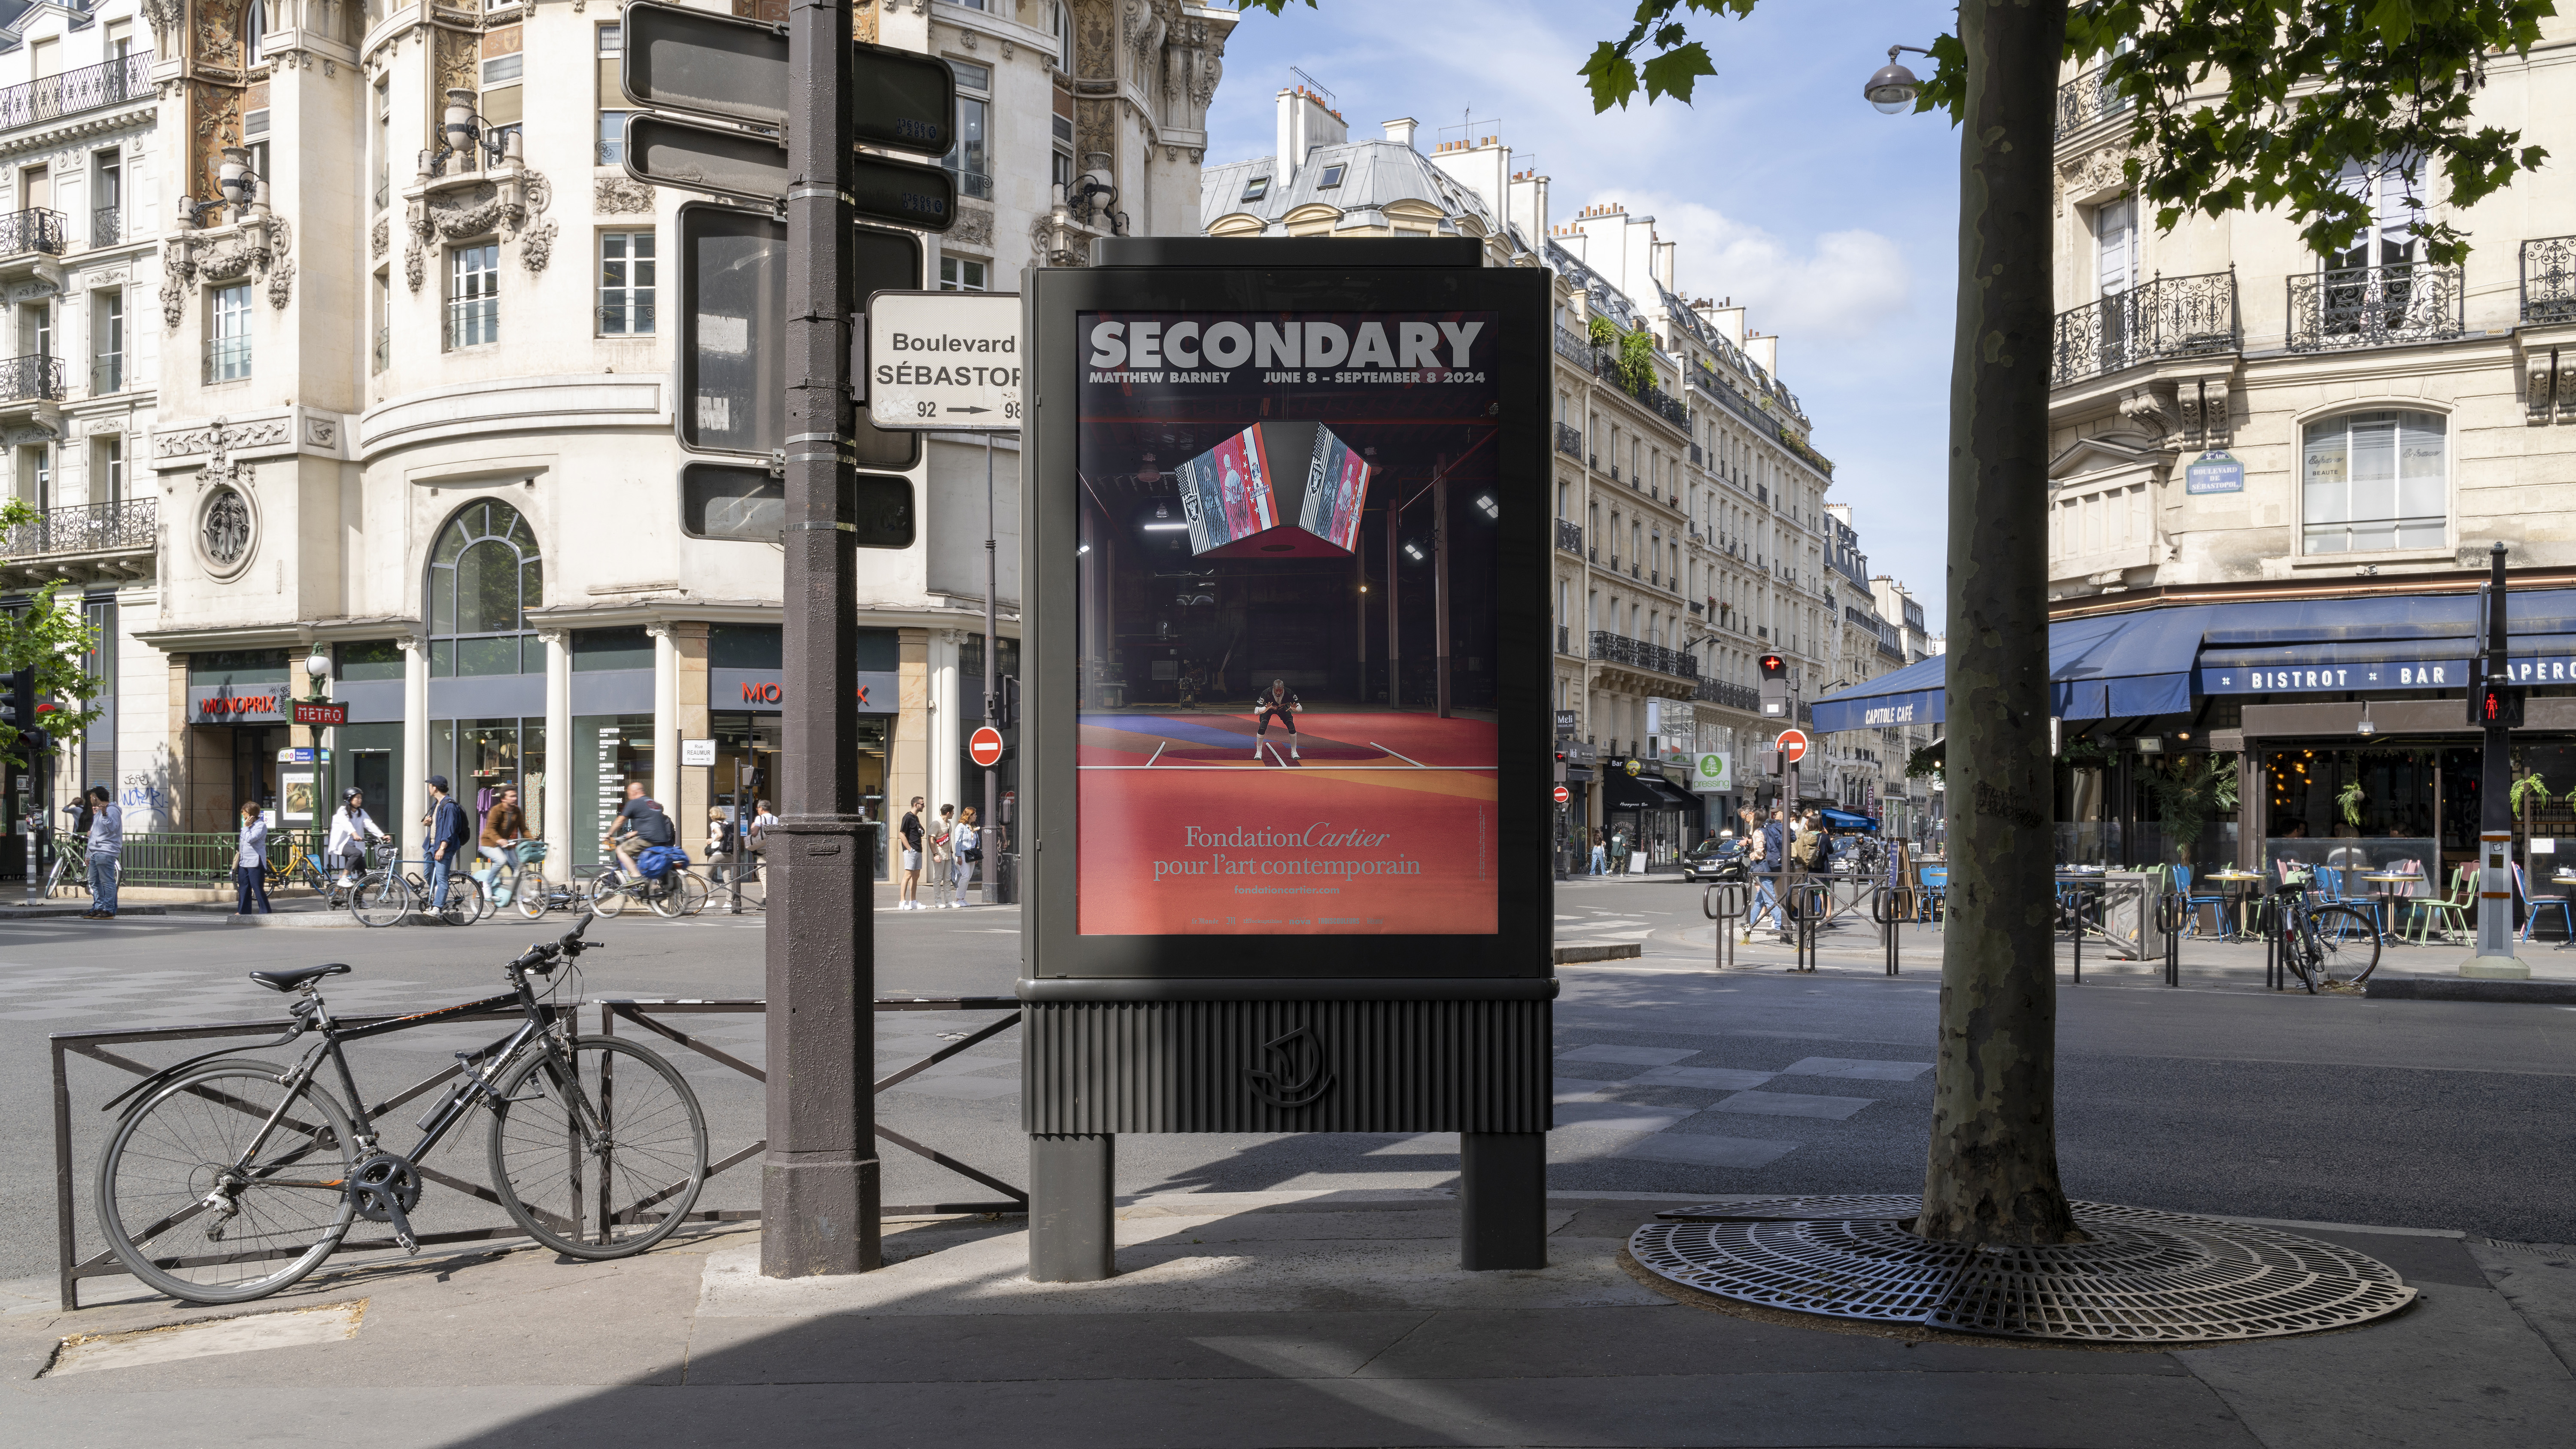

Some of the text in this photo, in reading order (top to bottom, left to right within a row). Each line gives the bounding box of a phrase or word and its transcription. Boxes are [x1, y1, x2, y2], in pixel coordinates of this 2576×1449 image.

[893, 333, 1015, 352] Boulevard
[1090, 321, 1485, 368] SECONDARY
[1089, 372, 1231, 383] MATTHEW BARNEY
[1263, 372, 1300, 383] JUNE
[1307, 372, 1316, 383] 8
[1335, 372, 1420, 383] SEPTEMBER
[1427, 372, 1436, 383] 8
[1443, 372, 1485, 383] 2024
[917, 401, 936, 417] 92
[2308, 455, 2344, 468] Espace
[2403, 448, 2441, 461] Espace
[2192, 482, 2238, 490] SÉBASTOPOL
[2252, 670, 2347, 688] BISTROT
[2401, 667, 2444, 684] BAR
[203, 696, 275, 713] MONOPRIX
[298, 707, 341, 721] METRO
[1865, 704, 1913, 724] CAPITOLE CAFÉ
[1693, 779, 1729, 789] pressing
[1153, 861, 1209, 881] pour
[1261, 854, 1421, 881] contemporain
[1234, 885, 1340, 894] fondationcartier.com
